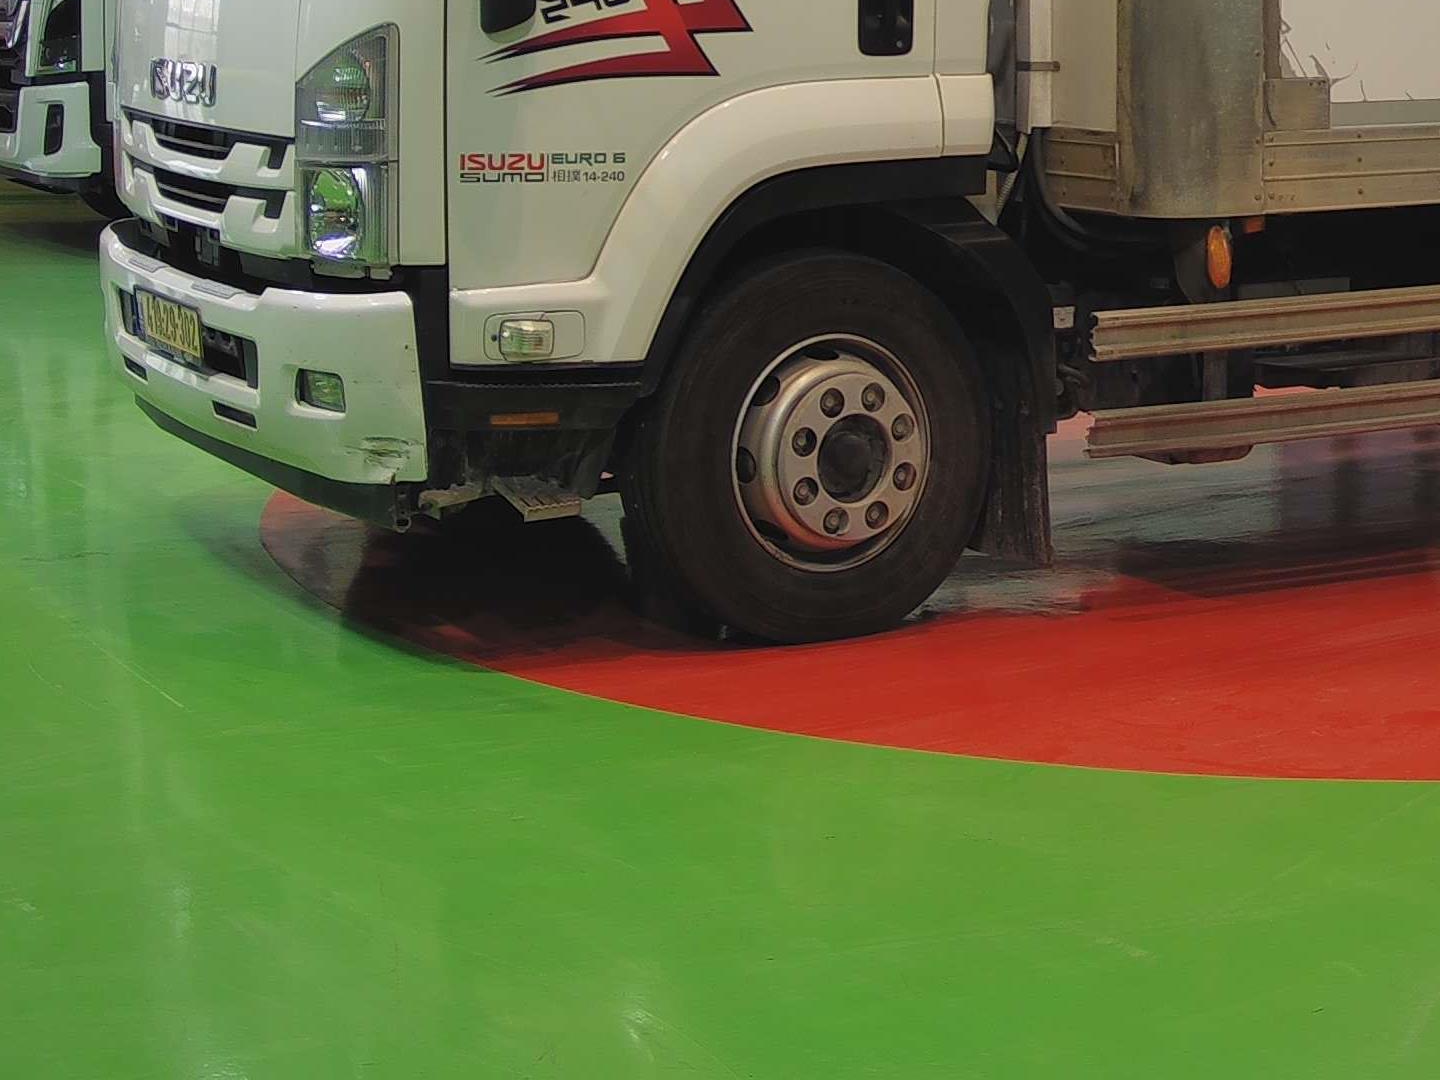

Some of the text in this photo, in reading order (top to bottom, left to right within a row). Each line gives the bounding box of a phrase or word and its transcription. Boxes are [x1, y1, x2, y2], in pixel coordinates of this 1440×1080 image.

[150, 58, 217, 108] ISUZU
[459, 153, 545, 171] ISUZU
[550, 152, 626, 167] EURO 6
